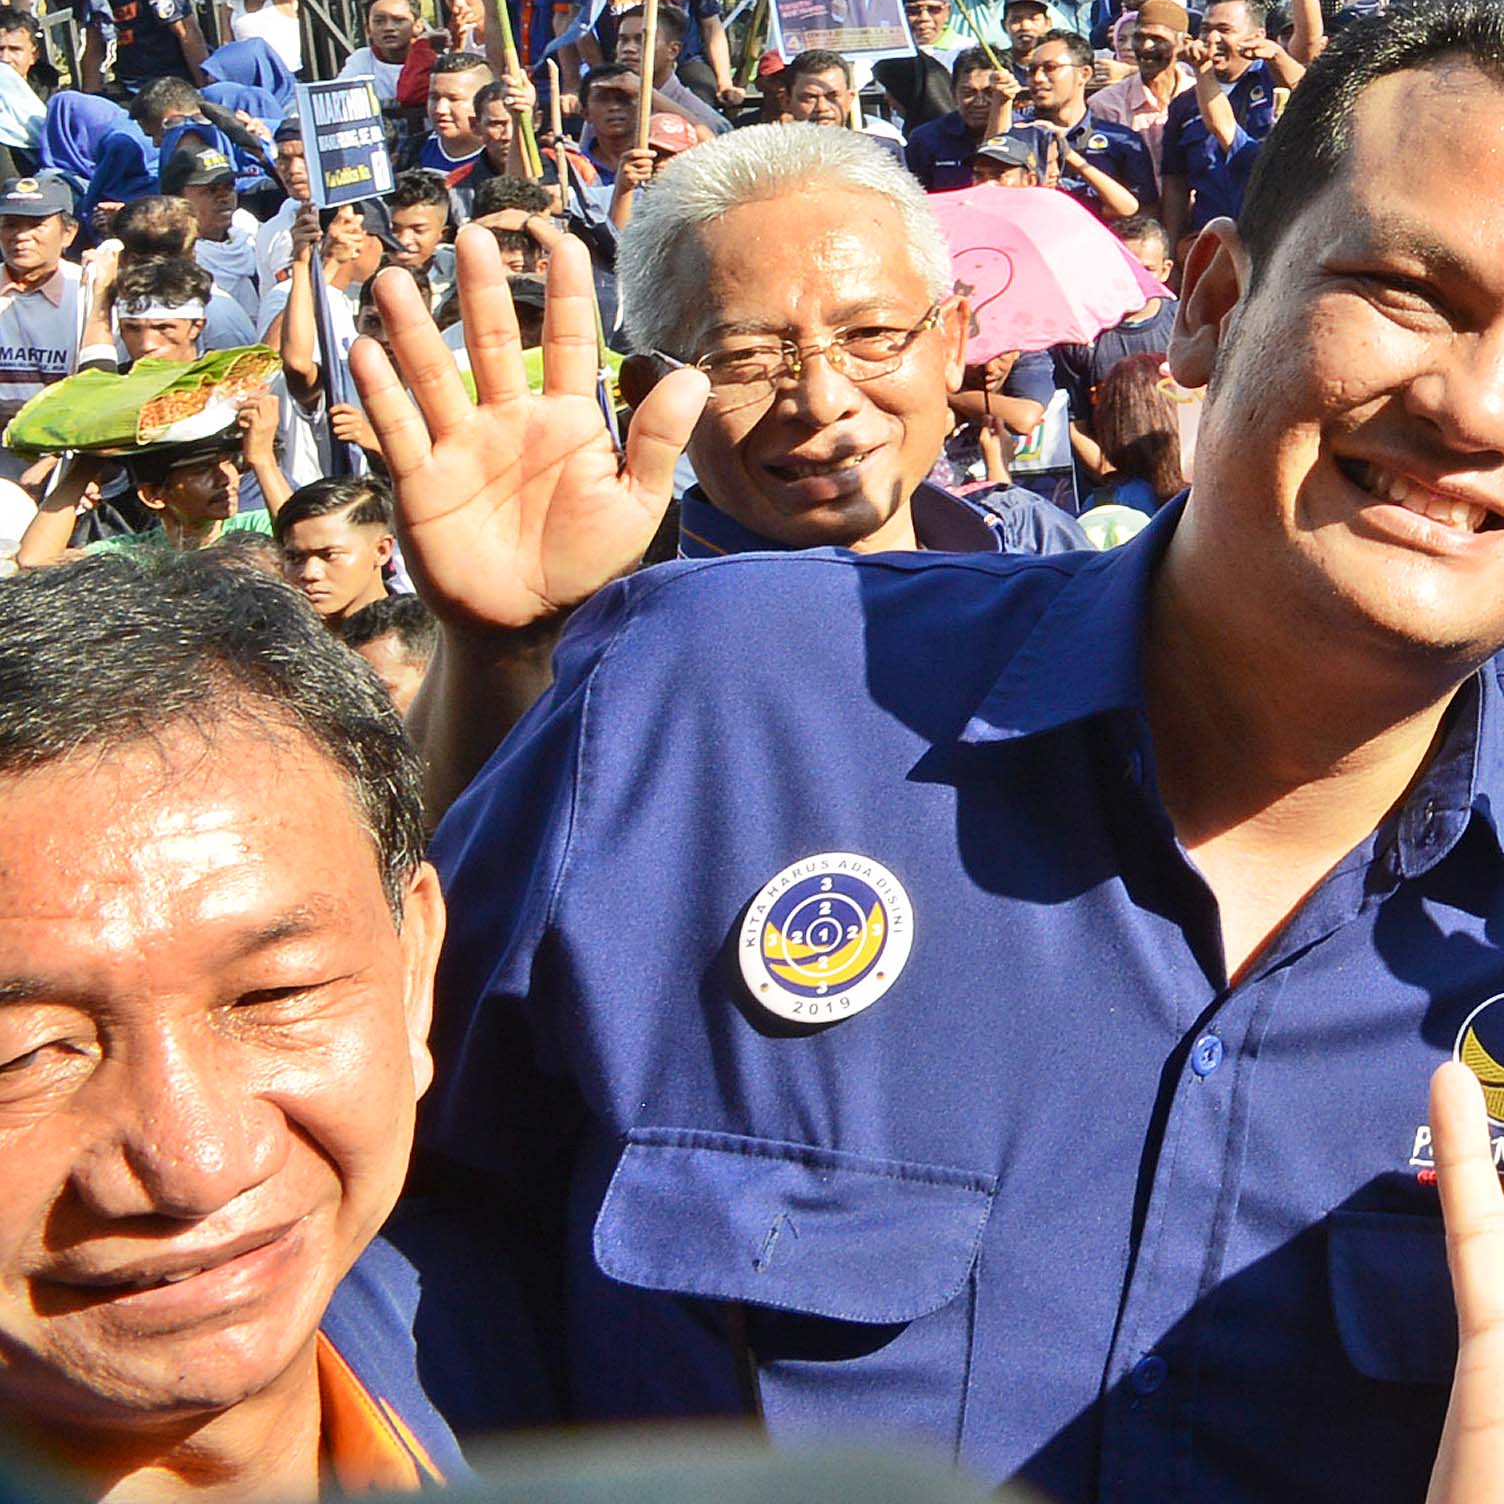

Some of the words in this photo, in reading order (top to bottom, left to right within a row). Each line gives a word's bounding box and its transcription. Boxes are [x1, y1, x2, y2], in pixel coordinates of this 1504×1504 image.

[0, 346, 67, 364] MARTIN
[820, 877, 832, 891] 3
[746, 904, 767, 948] KITA
[767, 859, 829, 898] HARUS
[838, 859, 872, 878] ADA
[876, 878, 904, 933] DISINI
[819, 901, 832, 915] 2
[768, 934, 778, 946] 3
[791, 931, 803, 944] 2
[818, 928, 829, 941] 1
[846, 925, 859, 939] 2
[871, 924, 882, 936] 3
[818, 956, 829, 969] 2
[815, 981, 828, 994] 3
[792, 996, 851, 1015] 2019
